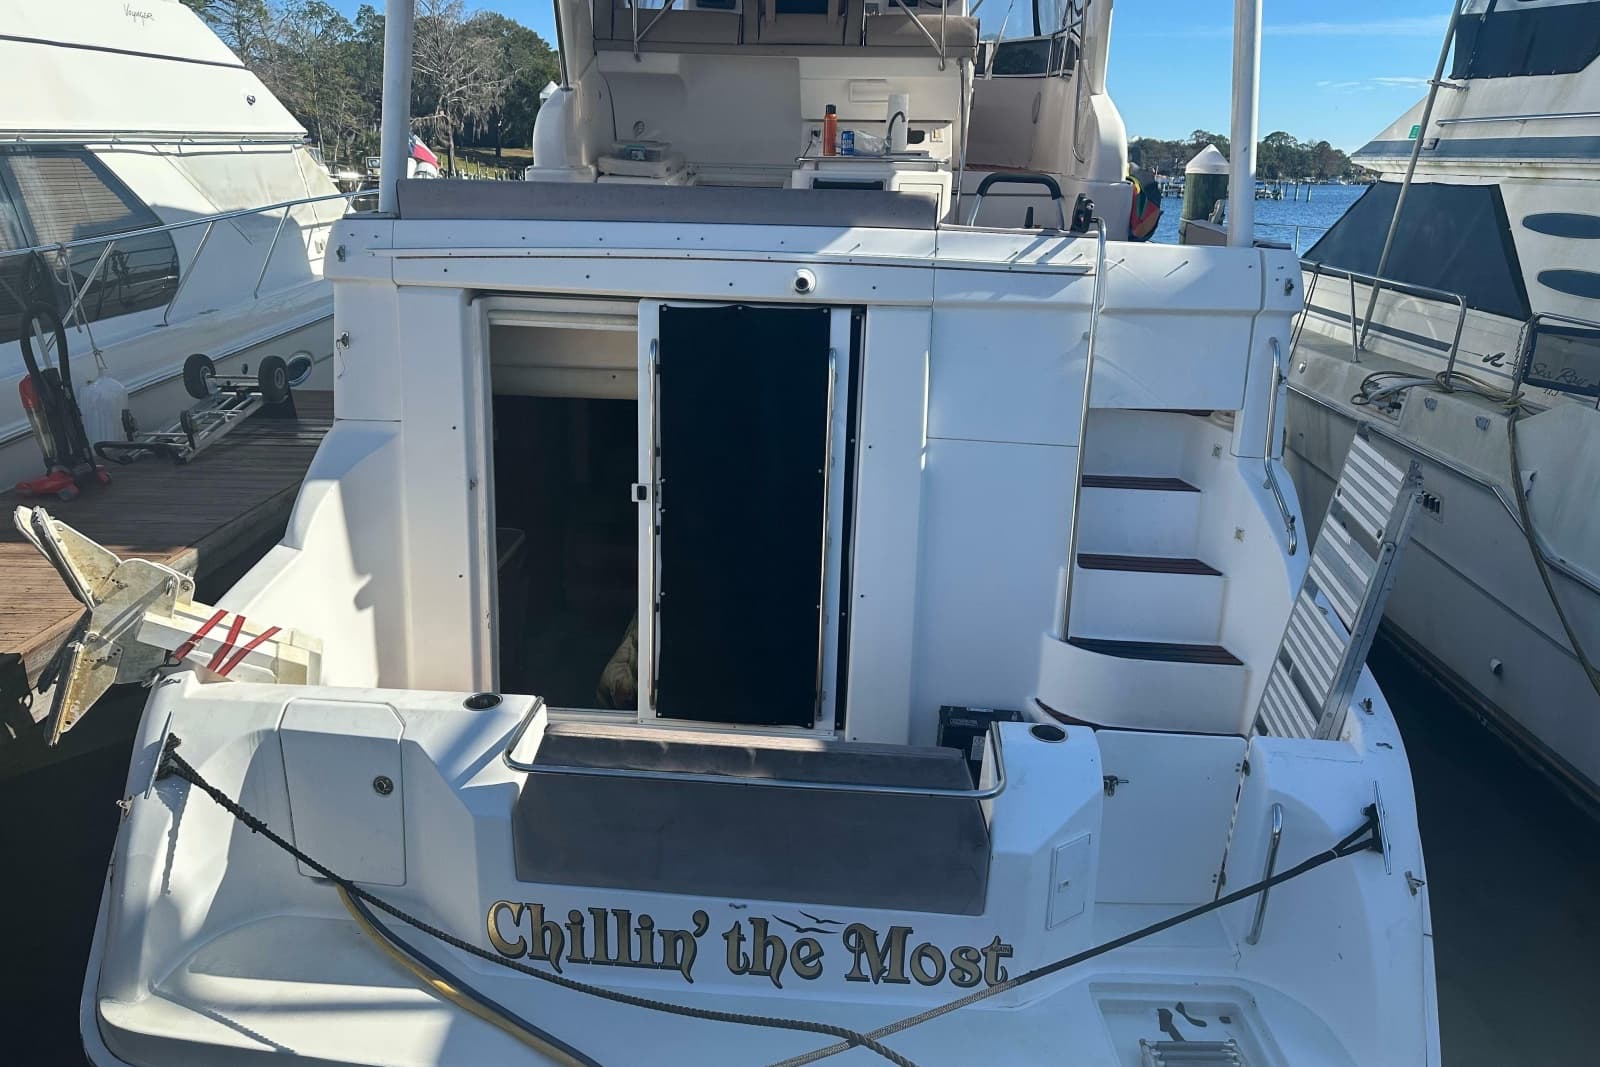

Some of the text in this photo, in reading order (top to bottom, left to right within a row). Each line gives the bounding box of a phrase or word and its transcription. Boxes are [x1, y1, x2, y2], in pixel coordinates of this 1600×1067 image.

[487, 900, 1013, 989] Chillin' the Most
